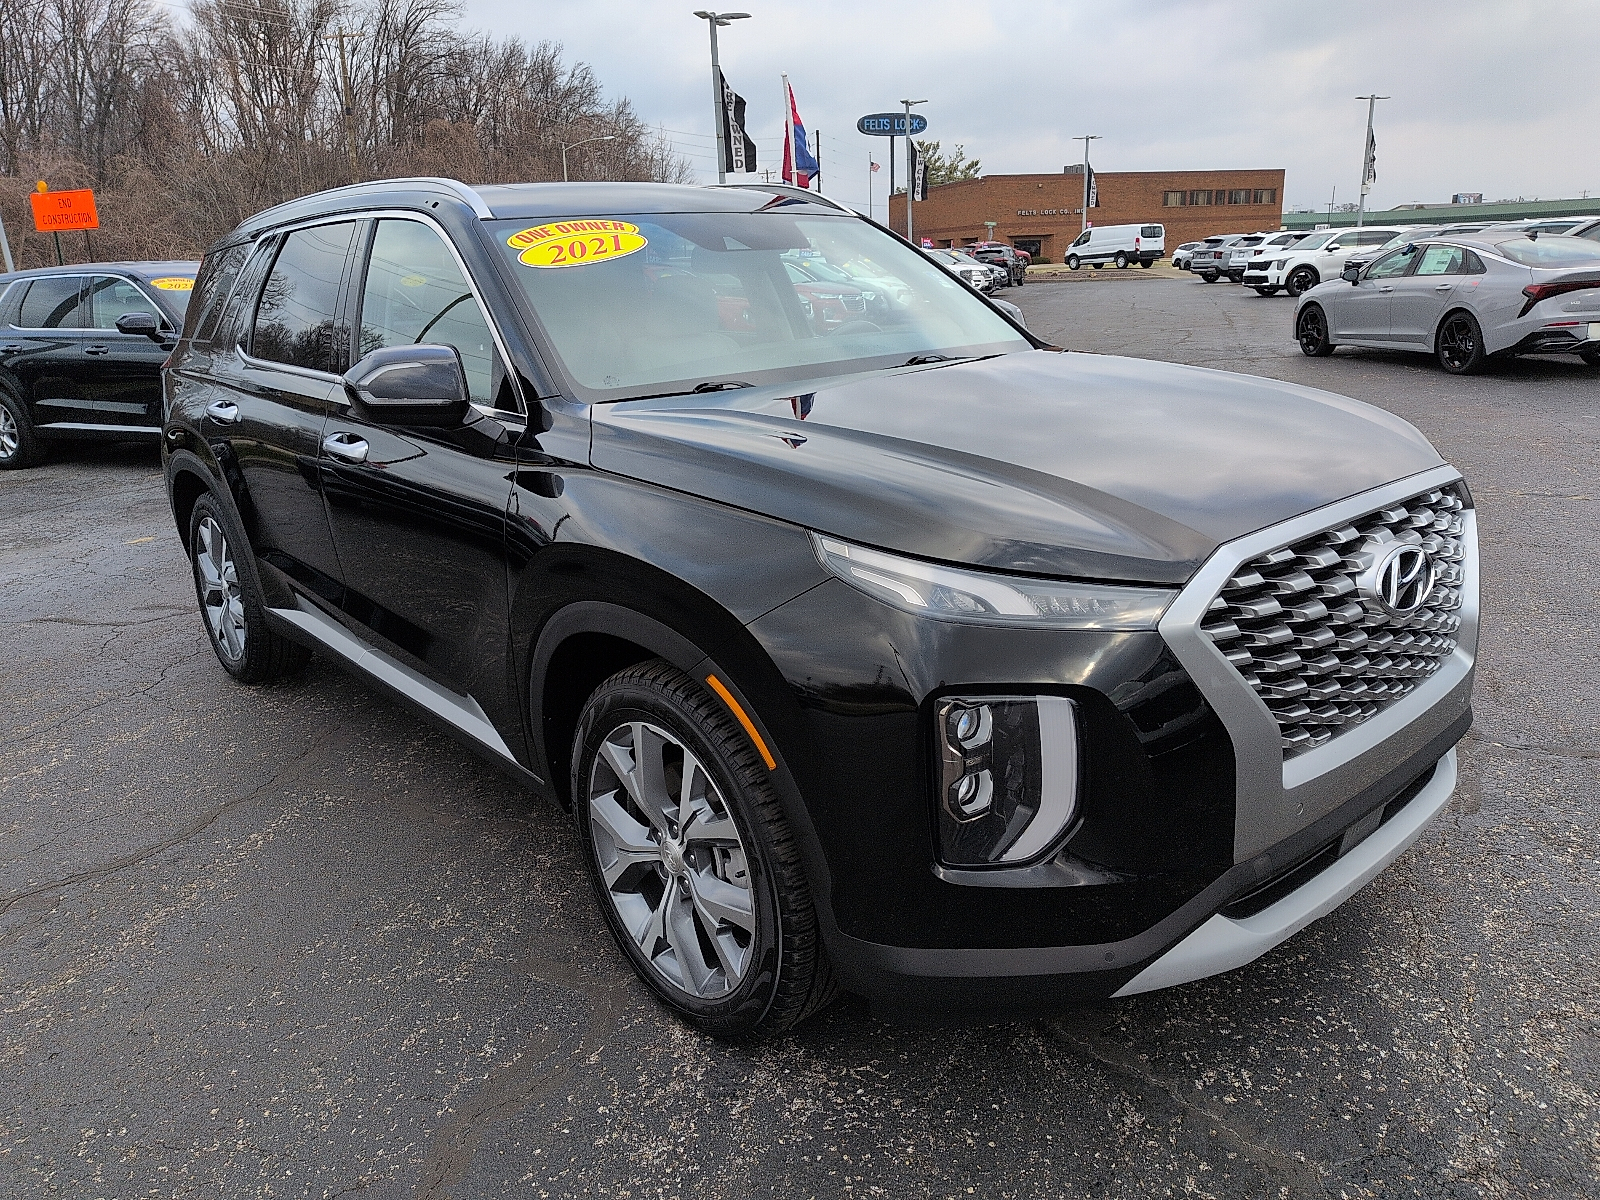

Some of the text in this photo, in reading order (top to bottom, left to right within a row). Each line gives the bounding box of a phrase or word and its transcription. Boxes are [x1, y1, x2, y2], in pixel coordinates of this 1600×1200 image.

[864, 119, 890, 130] FELTS
[58, 198, 72, 208] END
[43, 212, 93, 225] CONSTRUCTION
[515, 221, 625, 244] ONE OWNER
[547, 234, 625, 265] 2021
